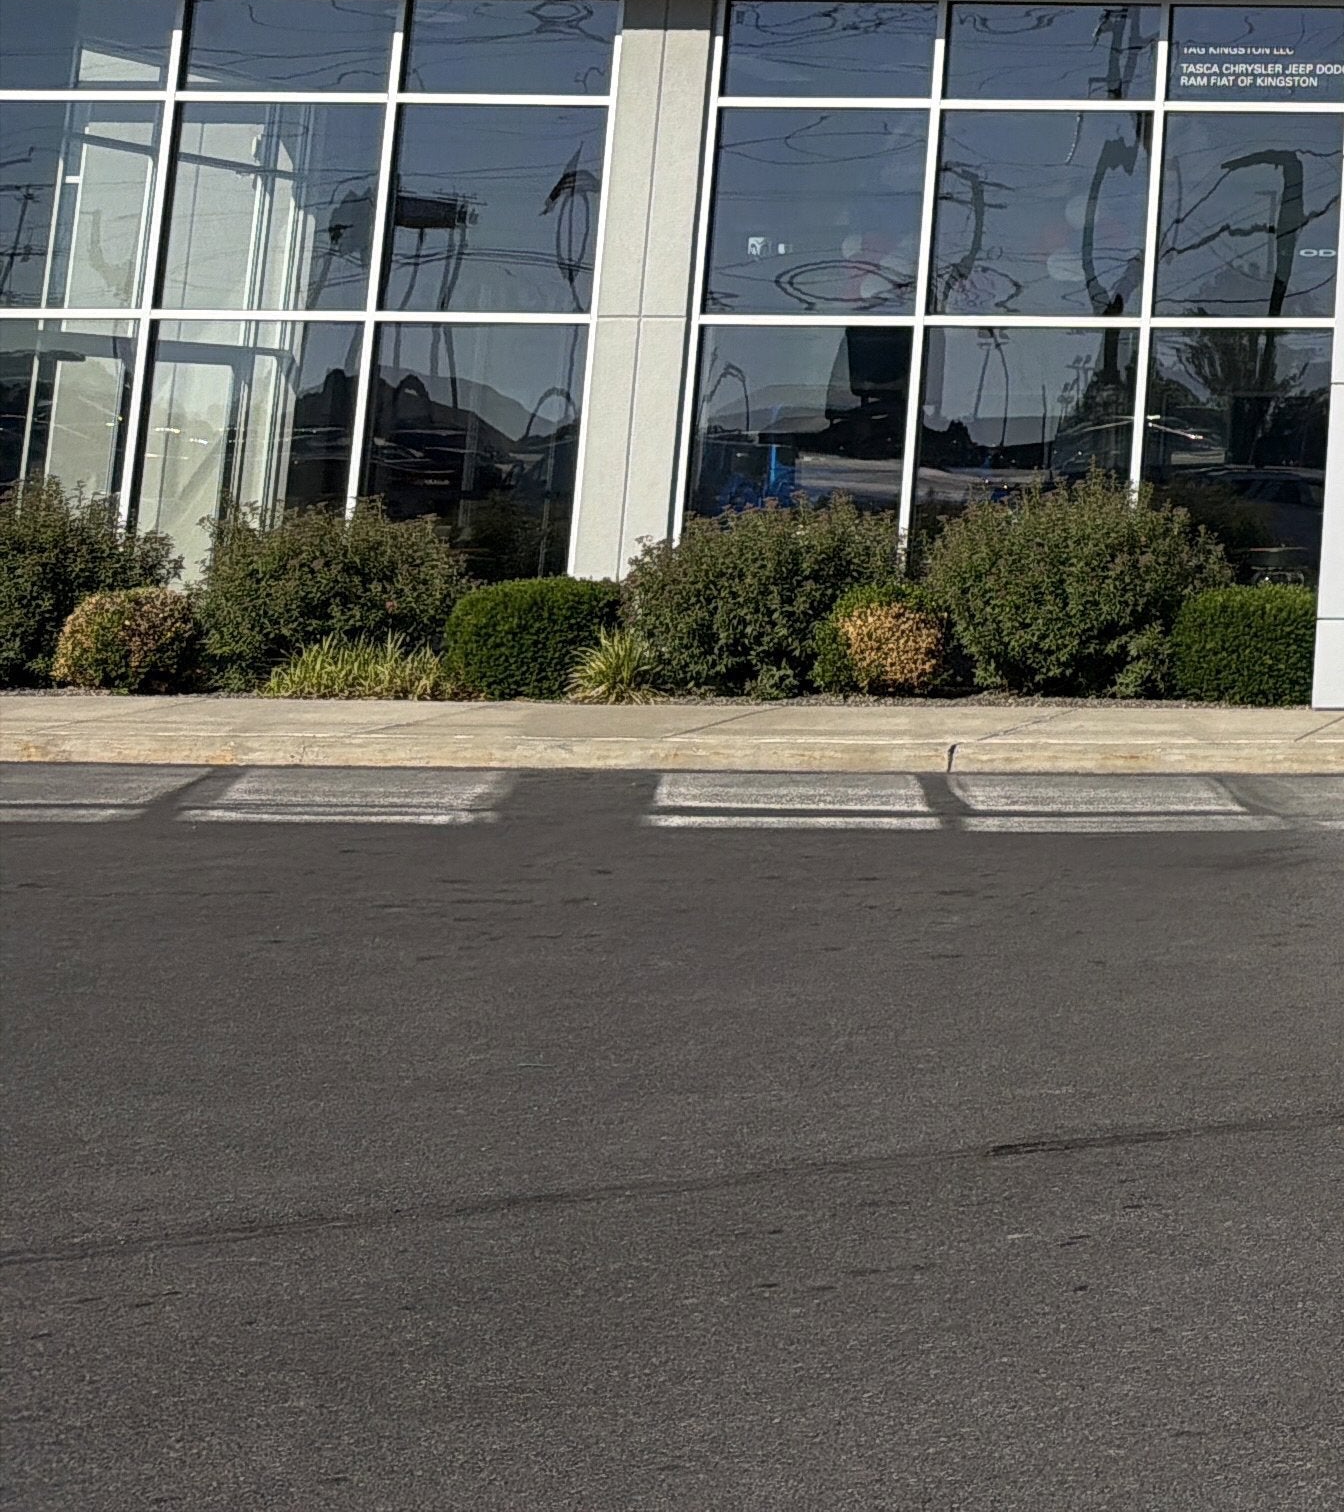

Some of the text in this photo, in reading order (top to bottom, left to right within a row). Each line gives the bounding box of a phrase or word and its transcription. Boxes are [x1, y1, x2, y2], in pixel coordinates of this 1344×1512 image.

[1181, 63, 1219, 74] TASCA
[1222, 63, 1283, 75] CHRYSLER
[1285, 64, 1314, 75] JEEP
[1180, 76, 1318, 87] RAM FIAT OF KINGSTON
